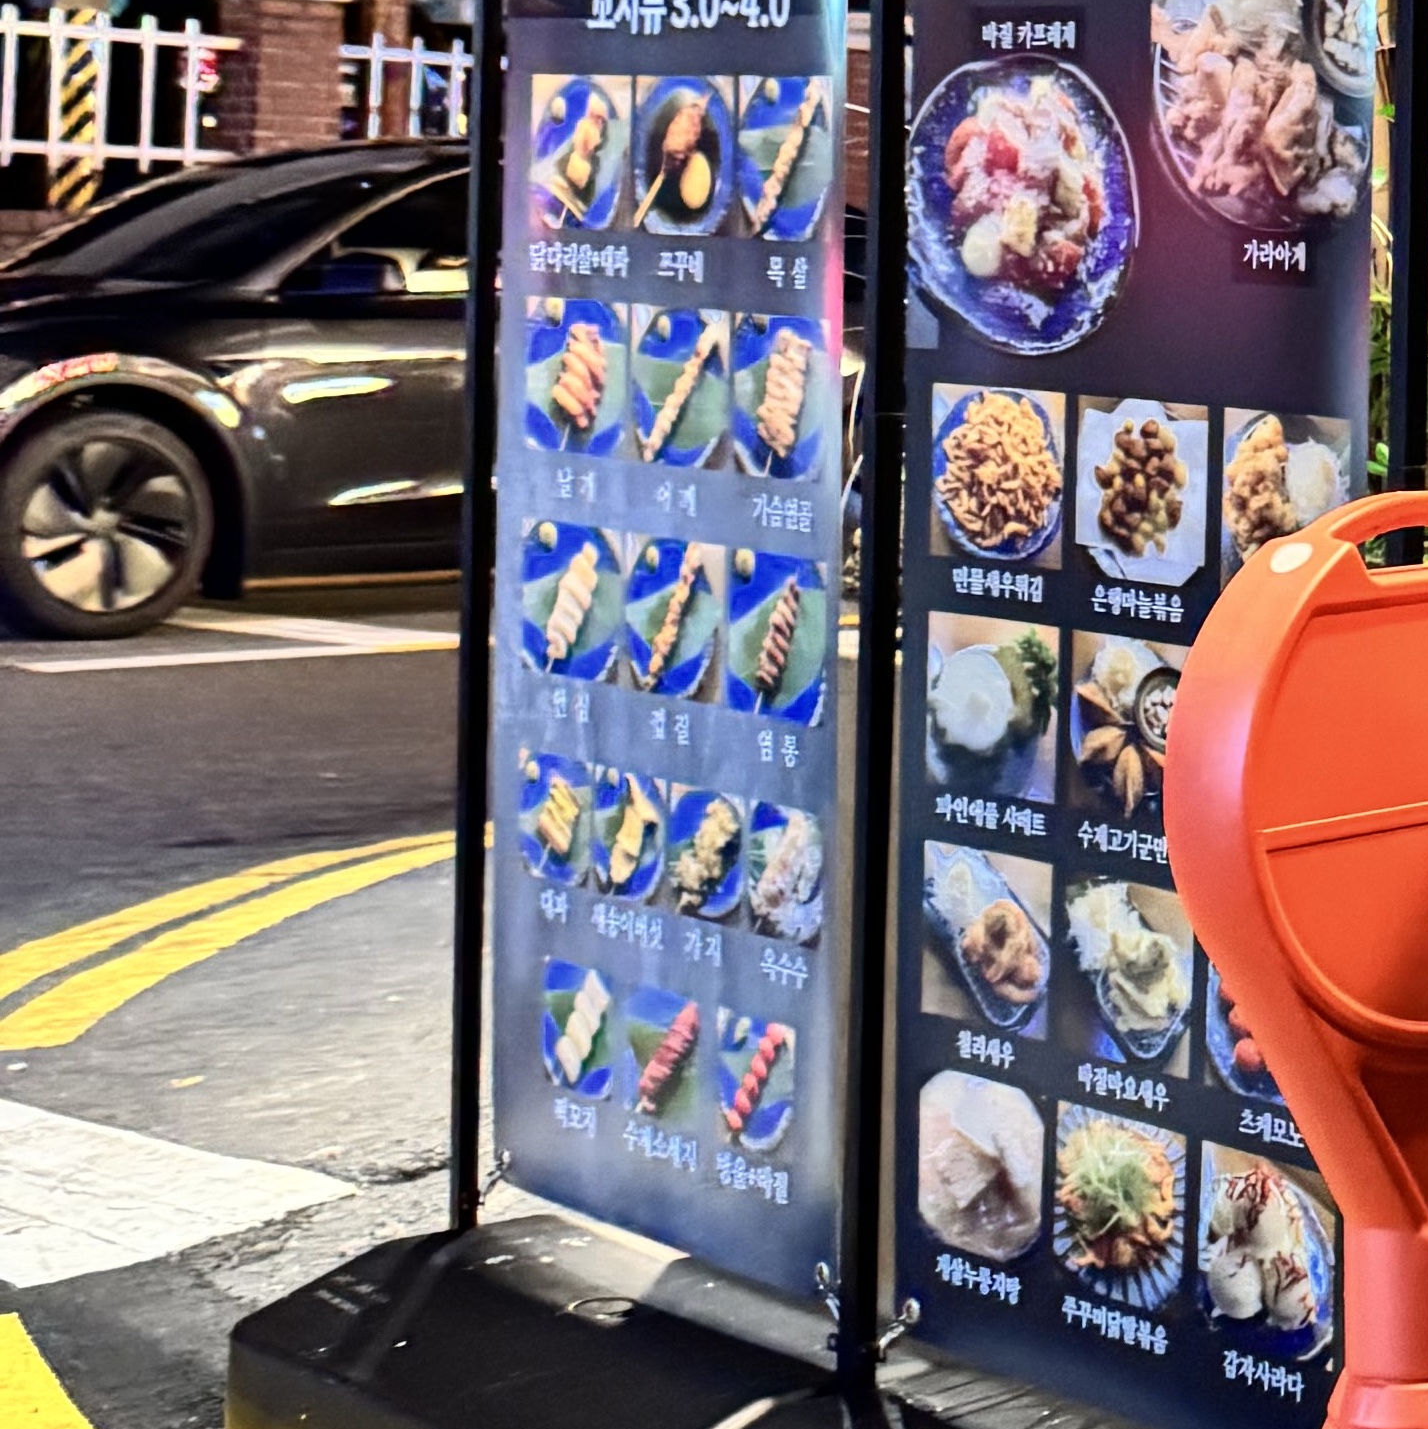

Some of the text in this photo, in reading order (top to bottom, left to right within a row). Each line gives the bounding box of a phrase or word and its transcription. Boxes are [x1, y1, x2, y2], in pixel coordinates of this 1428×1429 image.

[982, 20, 1076, 49] 바질 카프레제
[1243, 241, 1307, 272] 가라아게
[952, 565, 1043, 603] 민물새우튀김
[1091, 584, 1184, 623] 은행마늘볶음
[935, 793, 1000, 830] 파인애플
[1077, 820, 1168, 864] 수제고기군만
[760, 947, 809, 990] 옥수수
[956, 1030, 1015, 1069] 칠리새우
[1077, 1062, 1170, 1112] 바질마요새우
[1238, 1108, 1305, 1148] 츠케모노
[1223, 1349, 1305, 1403] 감자사라다
